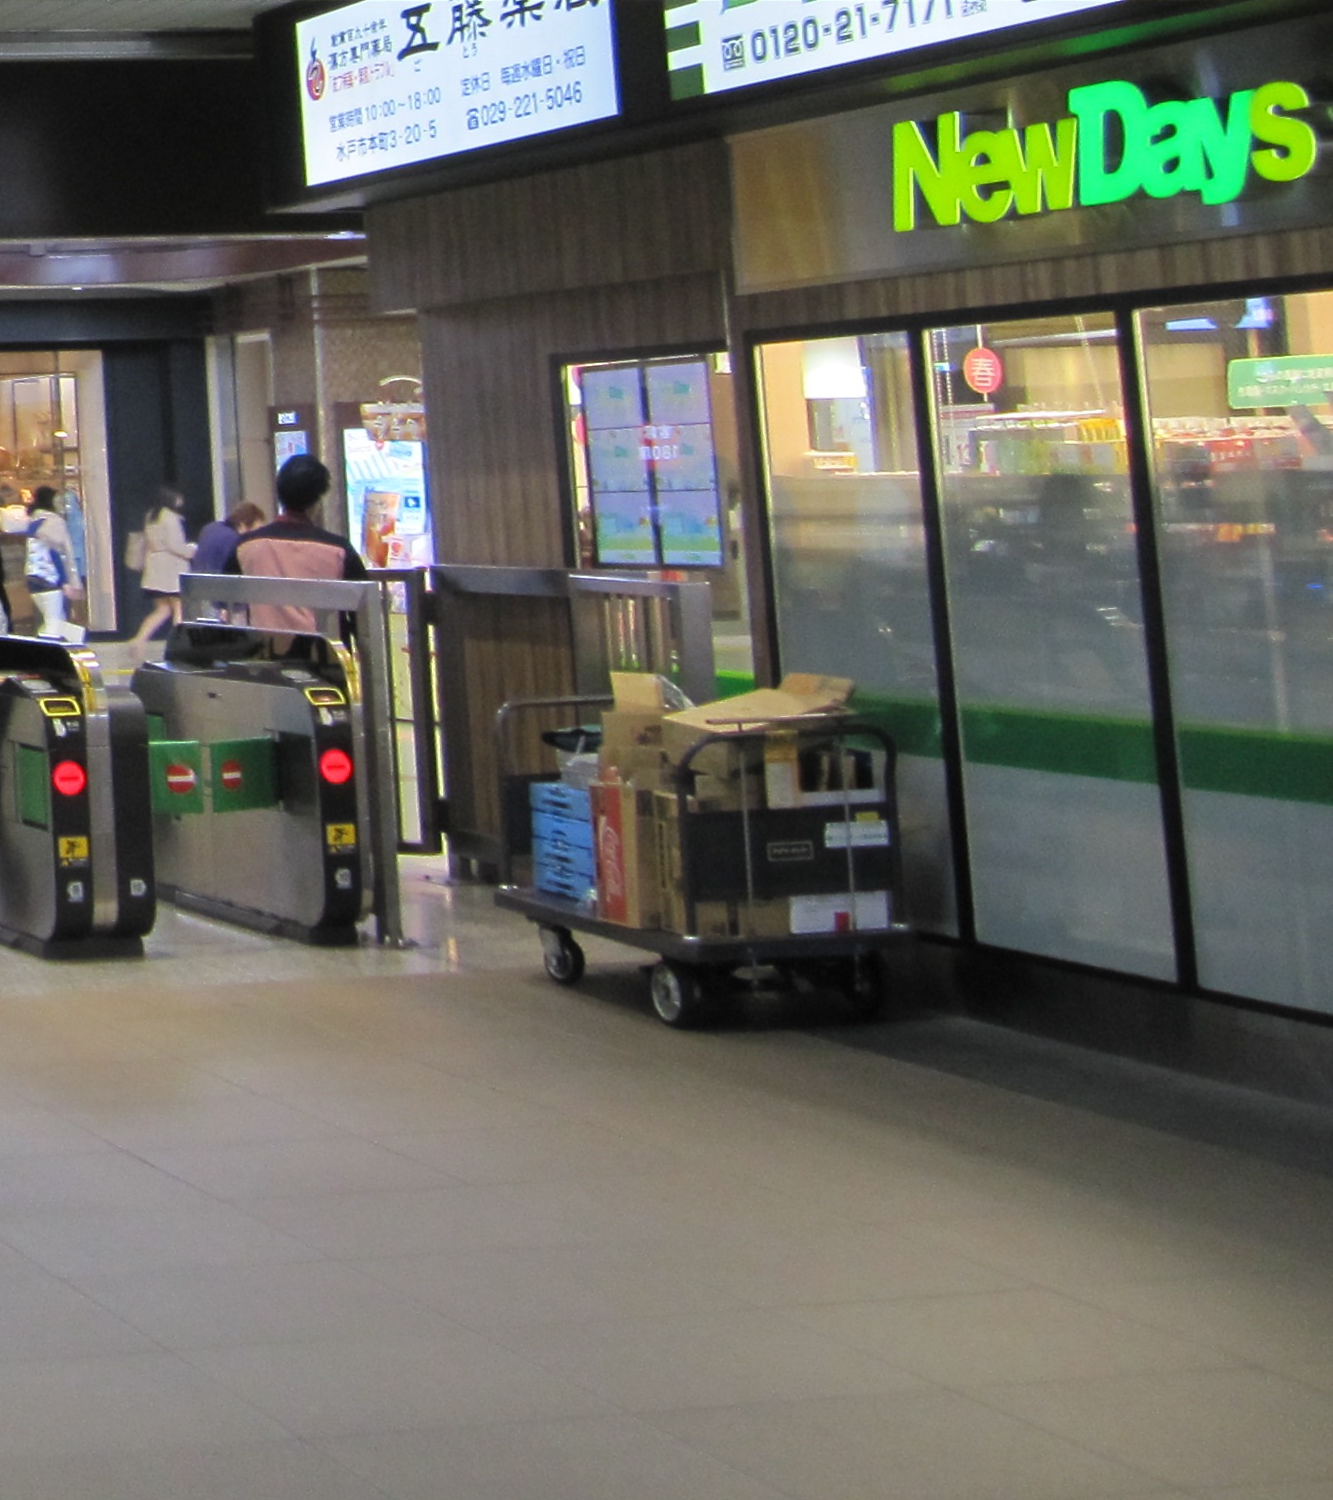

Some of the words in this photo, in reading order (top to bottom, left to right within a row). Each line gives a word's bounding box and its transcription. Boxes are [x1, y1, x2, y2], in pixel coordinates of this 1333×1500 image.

[482, 80, 583, 127] 029-221-5046
[892, 80, 1318, 233] NewDays
[971, 357, 997, 388] 春
